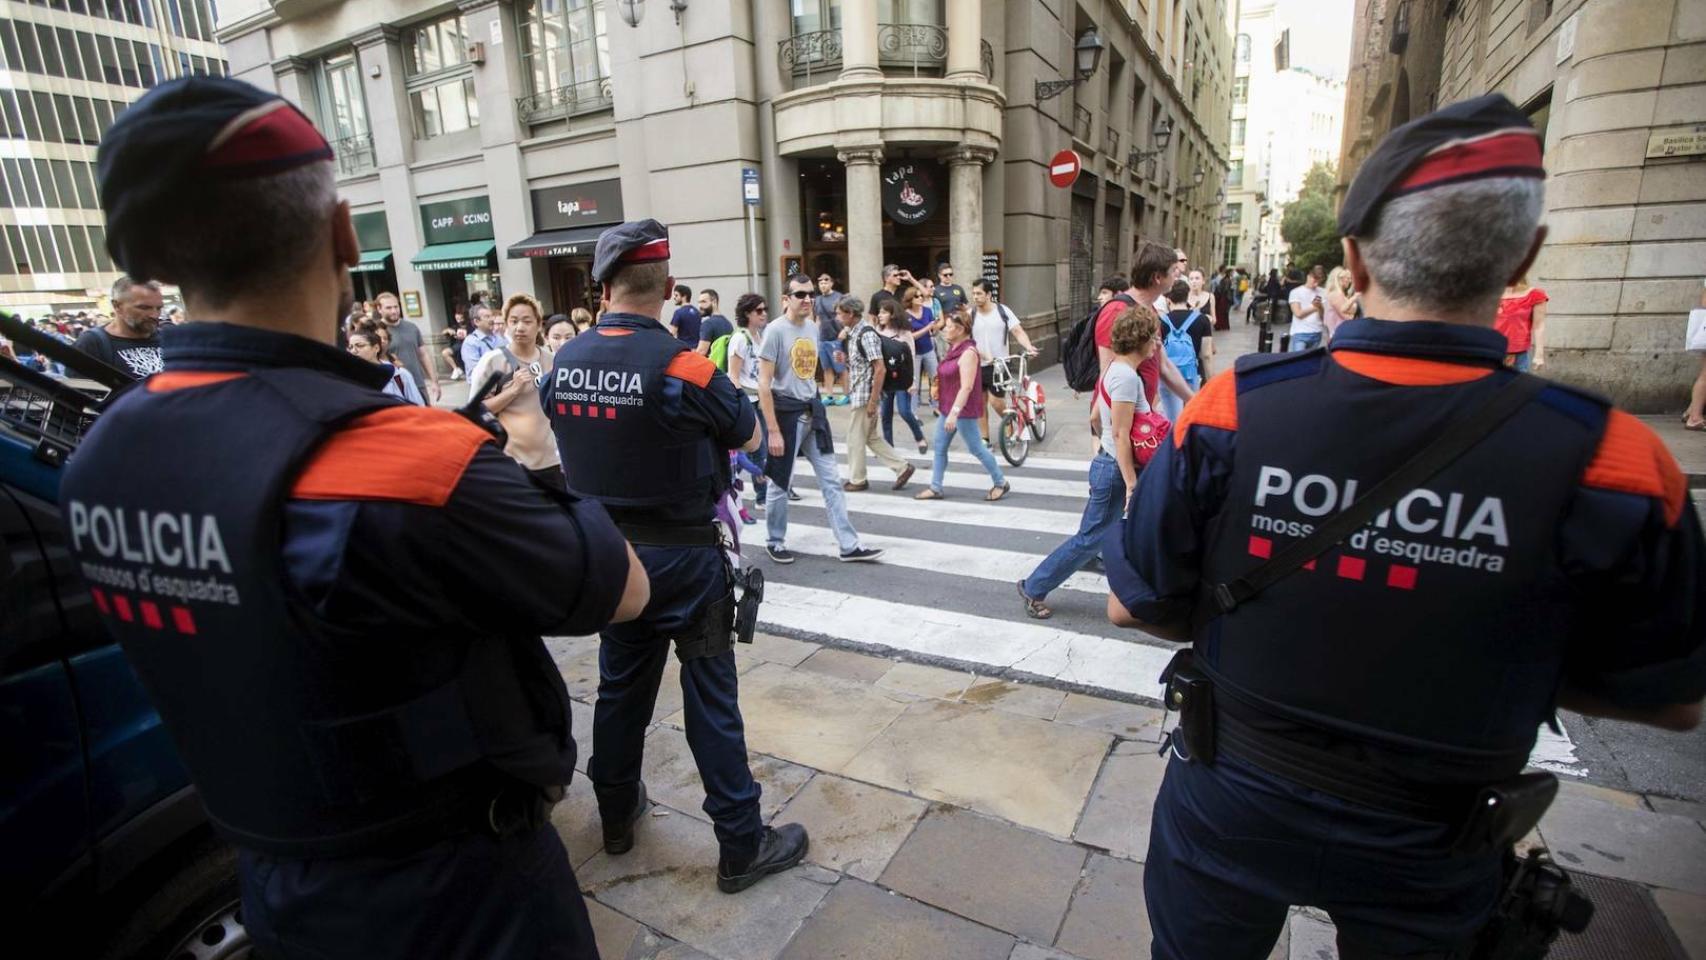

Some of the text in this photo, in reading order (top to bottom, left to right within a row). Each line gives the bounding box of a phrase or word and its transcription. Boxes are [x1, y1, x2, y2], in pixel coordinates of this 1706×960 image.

[553, 246, 577, 255] TAPAS
[555, 367, 644, 395] POLICIA
[555, 391, 589, 402] mossos
[69, 500, 233, 573] POLICIA
[1251, 513, 1345, 546] moss
[81, 562, 137, 590] mossos
